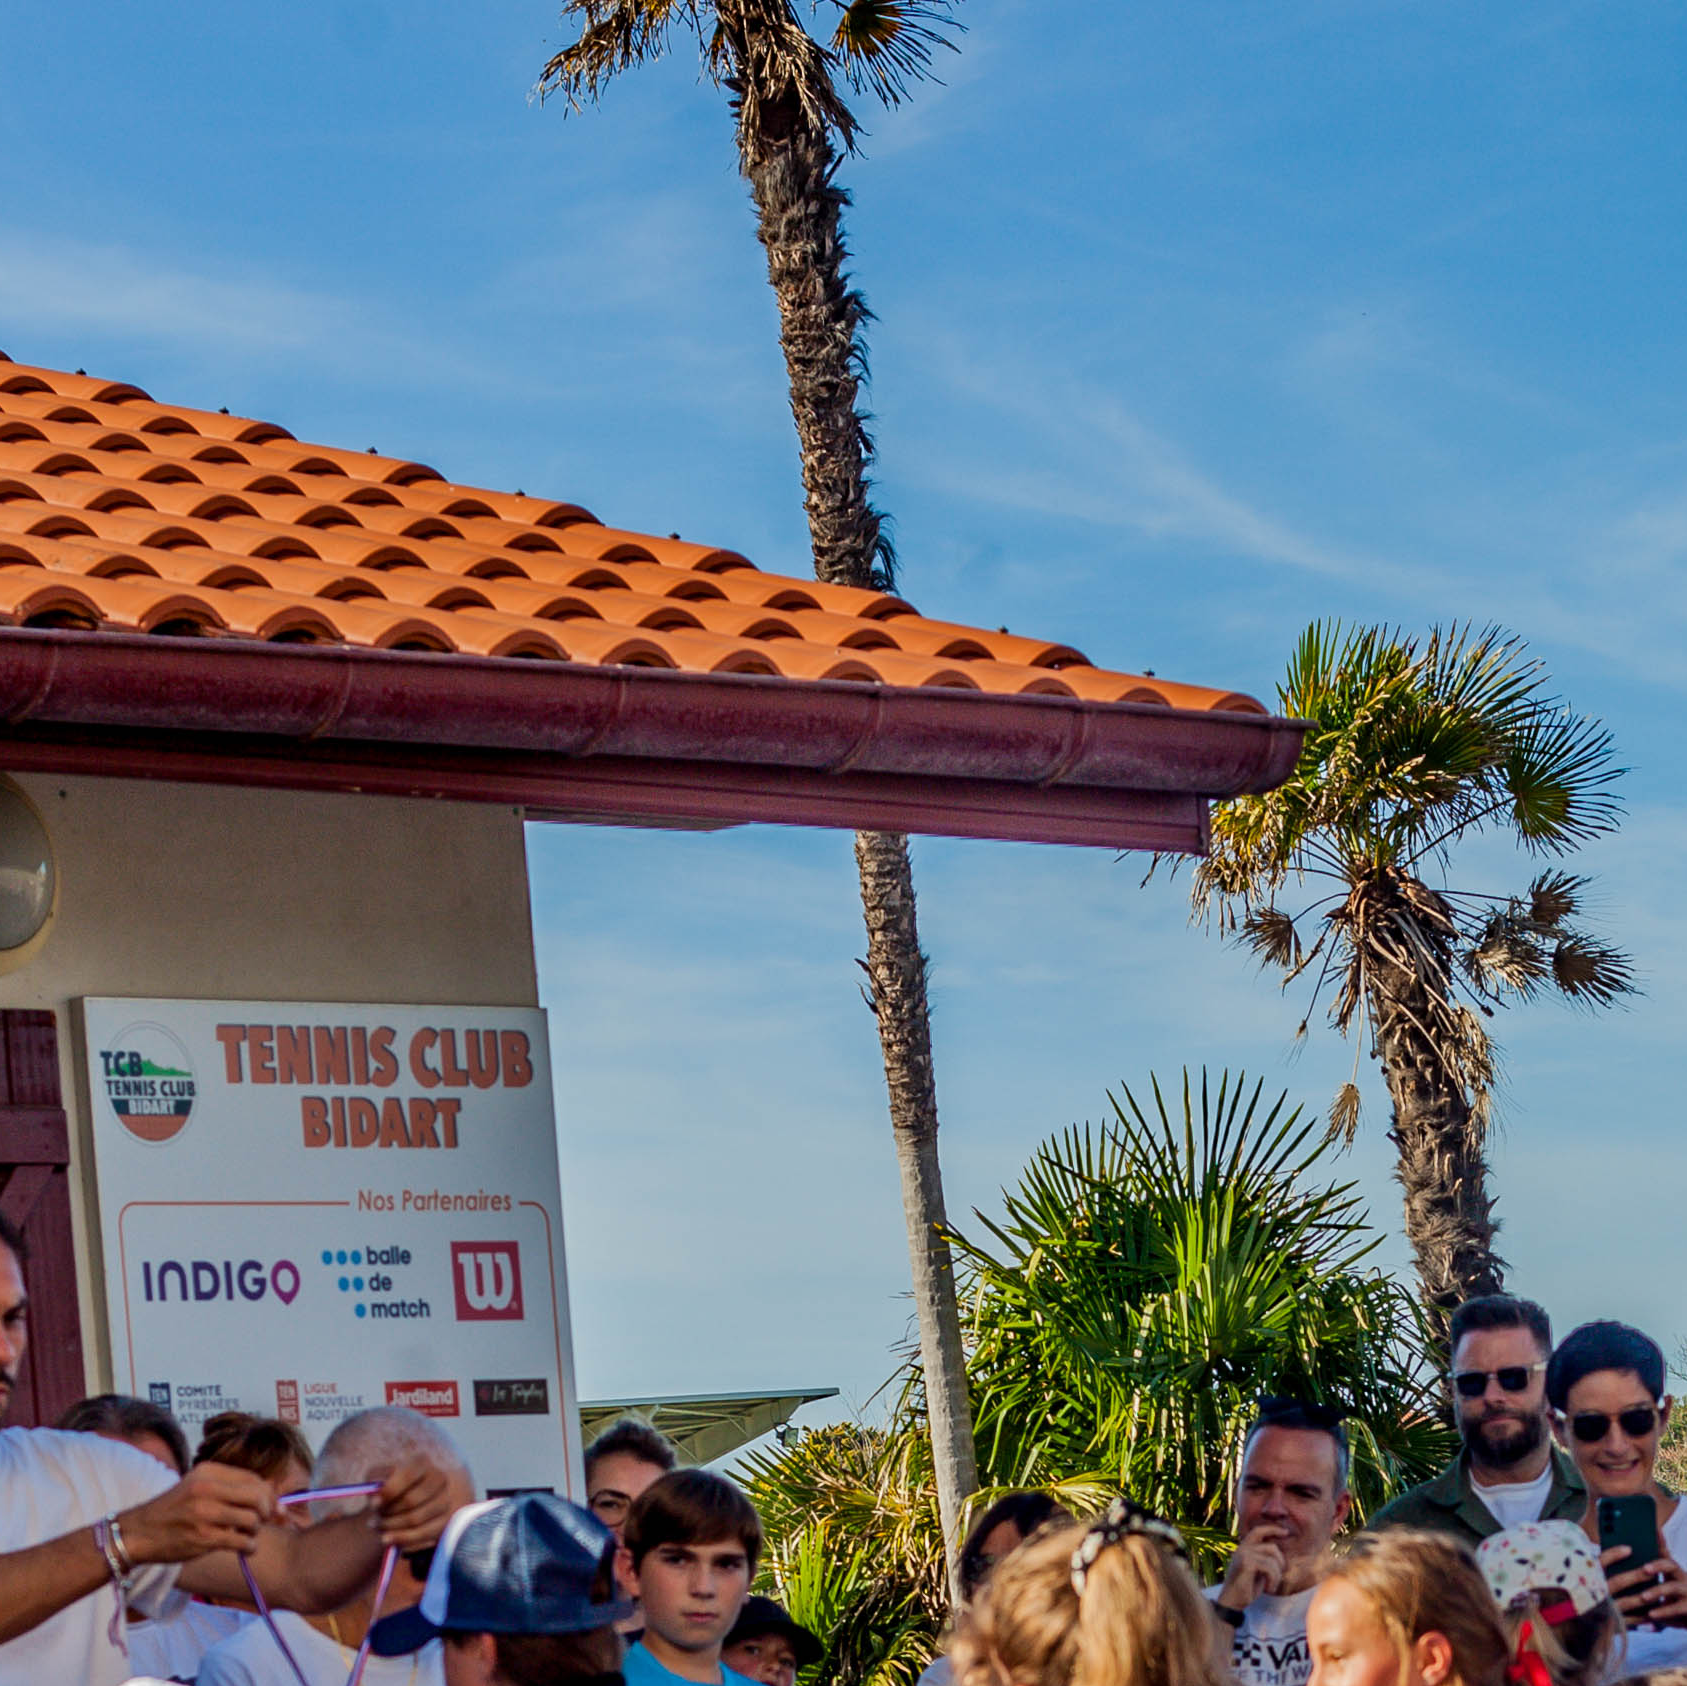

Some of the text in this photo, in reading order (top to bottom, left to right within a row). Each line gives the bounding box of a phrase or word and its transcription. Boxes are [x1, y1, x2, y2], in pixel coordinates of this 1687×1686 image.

[100, 1051, 143, 1077] TCB
[216, 1023, 534, 1090] TENNIS CLUB
[106, 1080, 196, 1097] TENNIS CLUB
[129, 1099, 176, 1115] BIDART
[301, 1096, 461, 1149] BIDART
[358, 1188, 512, 1213] Nos Partenaires
[366, 1245, 411, 1266] balle
[369, 1276, 392, 1293] de
[371, 1299, 430, 1319] match
[303, 1382, 338, 1394] LIGUE
[391, 1387, 454, 1406] Jardiland
